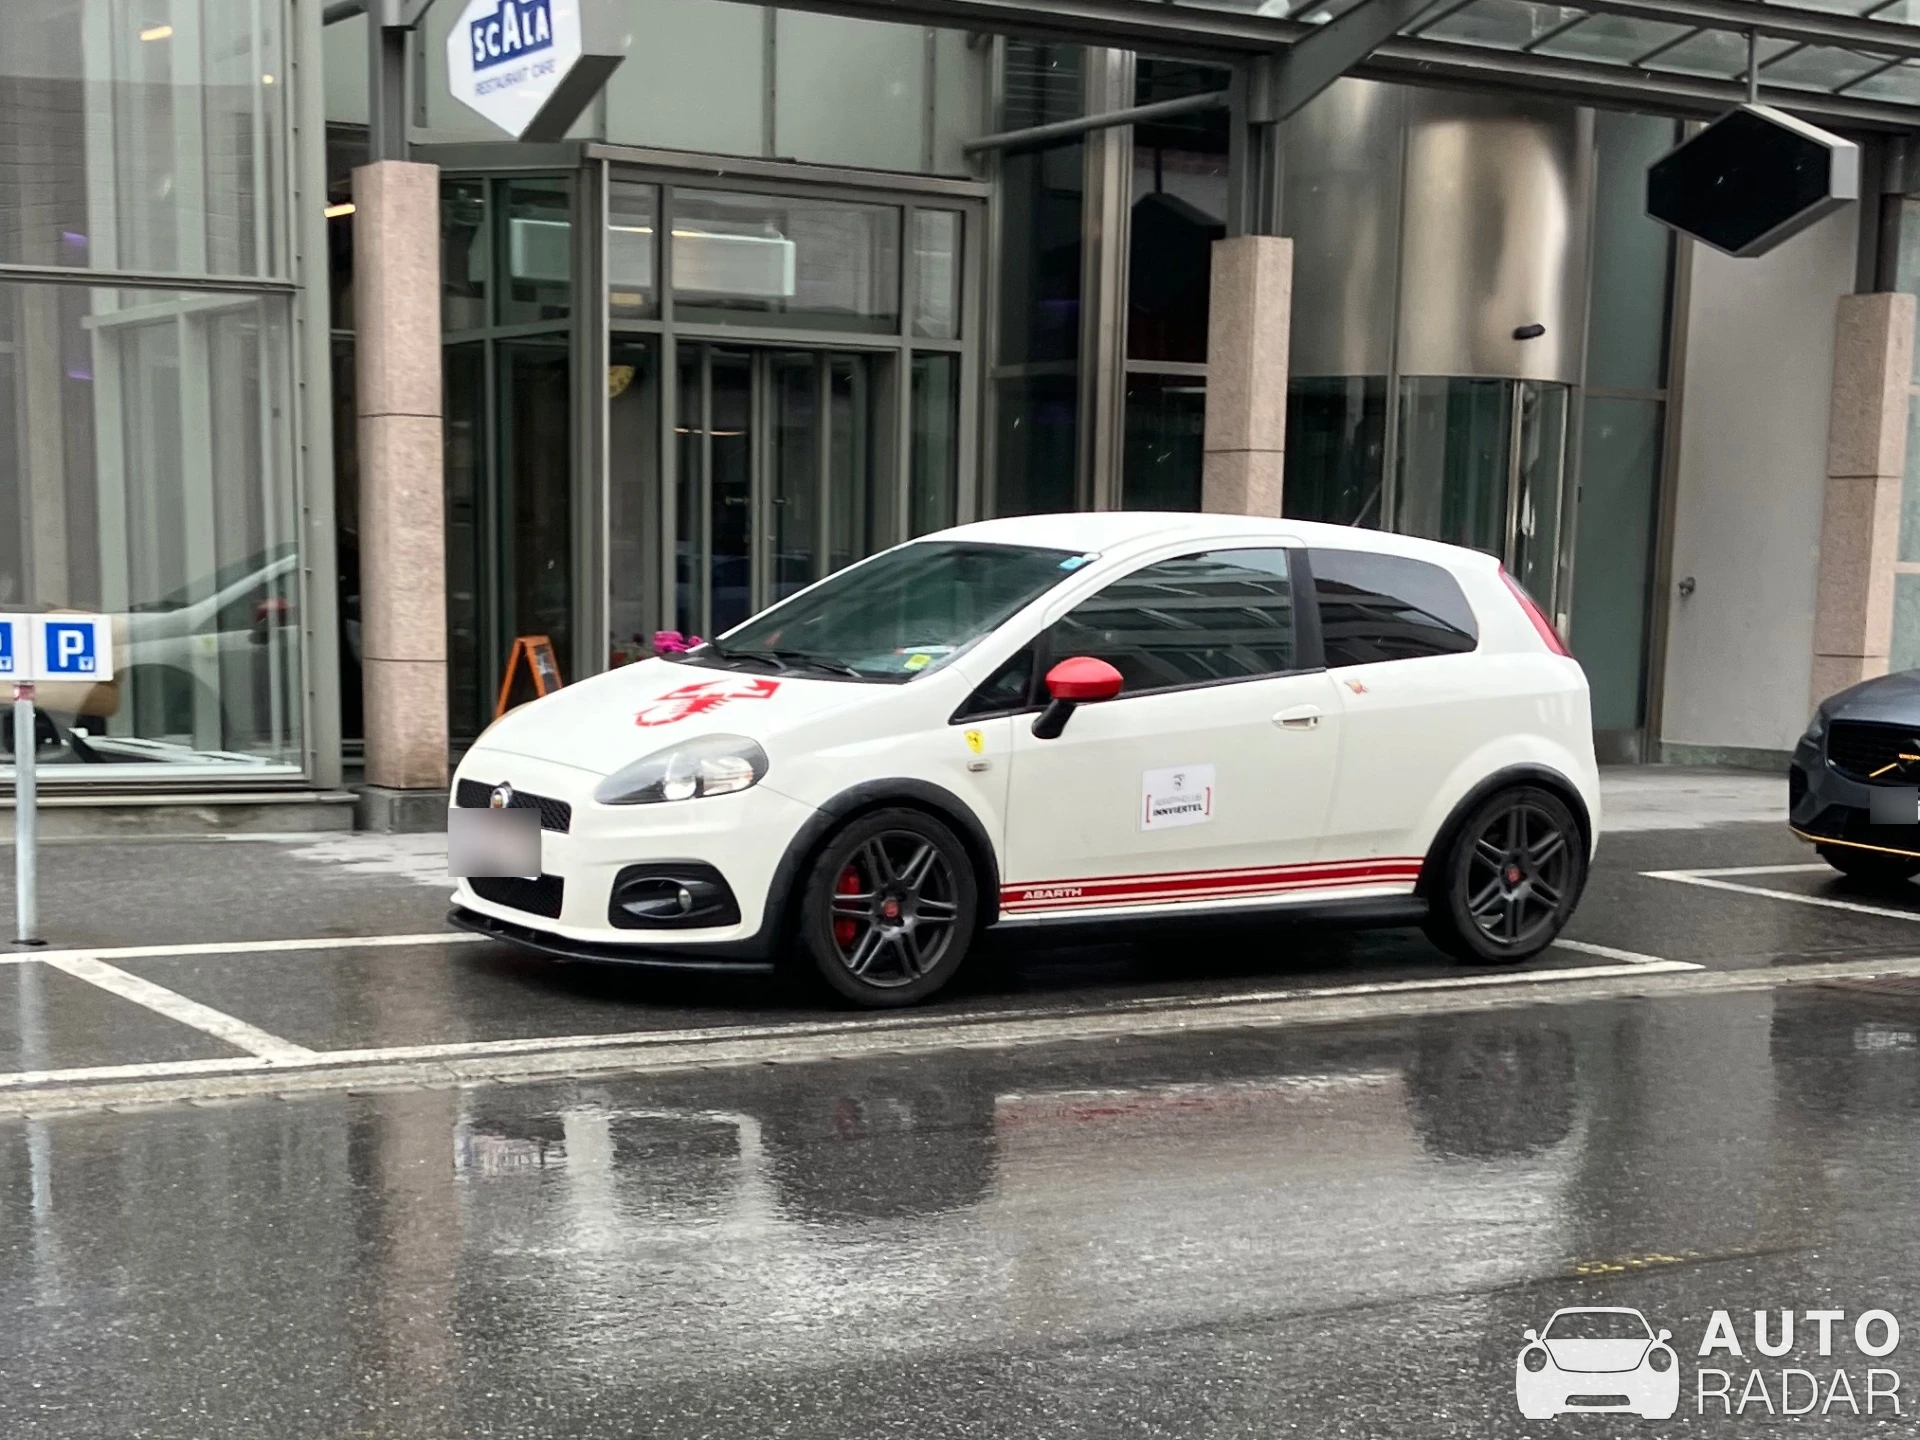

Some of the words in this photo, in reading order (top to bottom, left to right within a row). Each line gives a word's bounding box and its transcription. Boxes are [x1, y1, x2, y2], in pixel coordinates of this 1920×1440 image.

[473, 1, 550, 62] SCALA
[58, 630, 84, 668] P
[1153, 803, 1203, 816] INNVIERTEL
[1023, 888, 1083, 899] ABARTH
